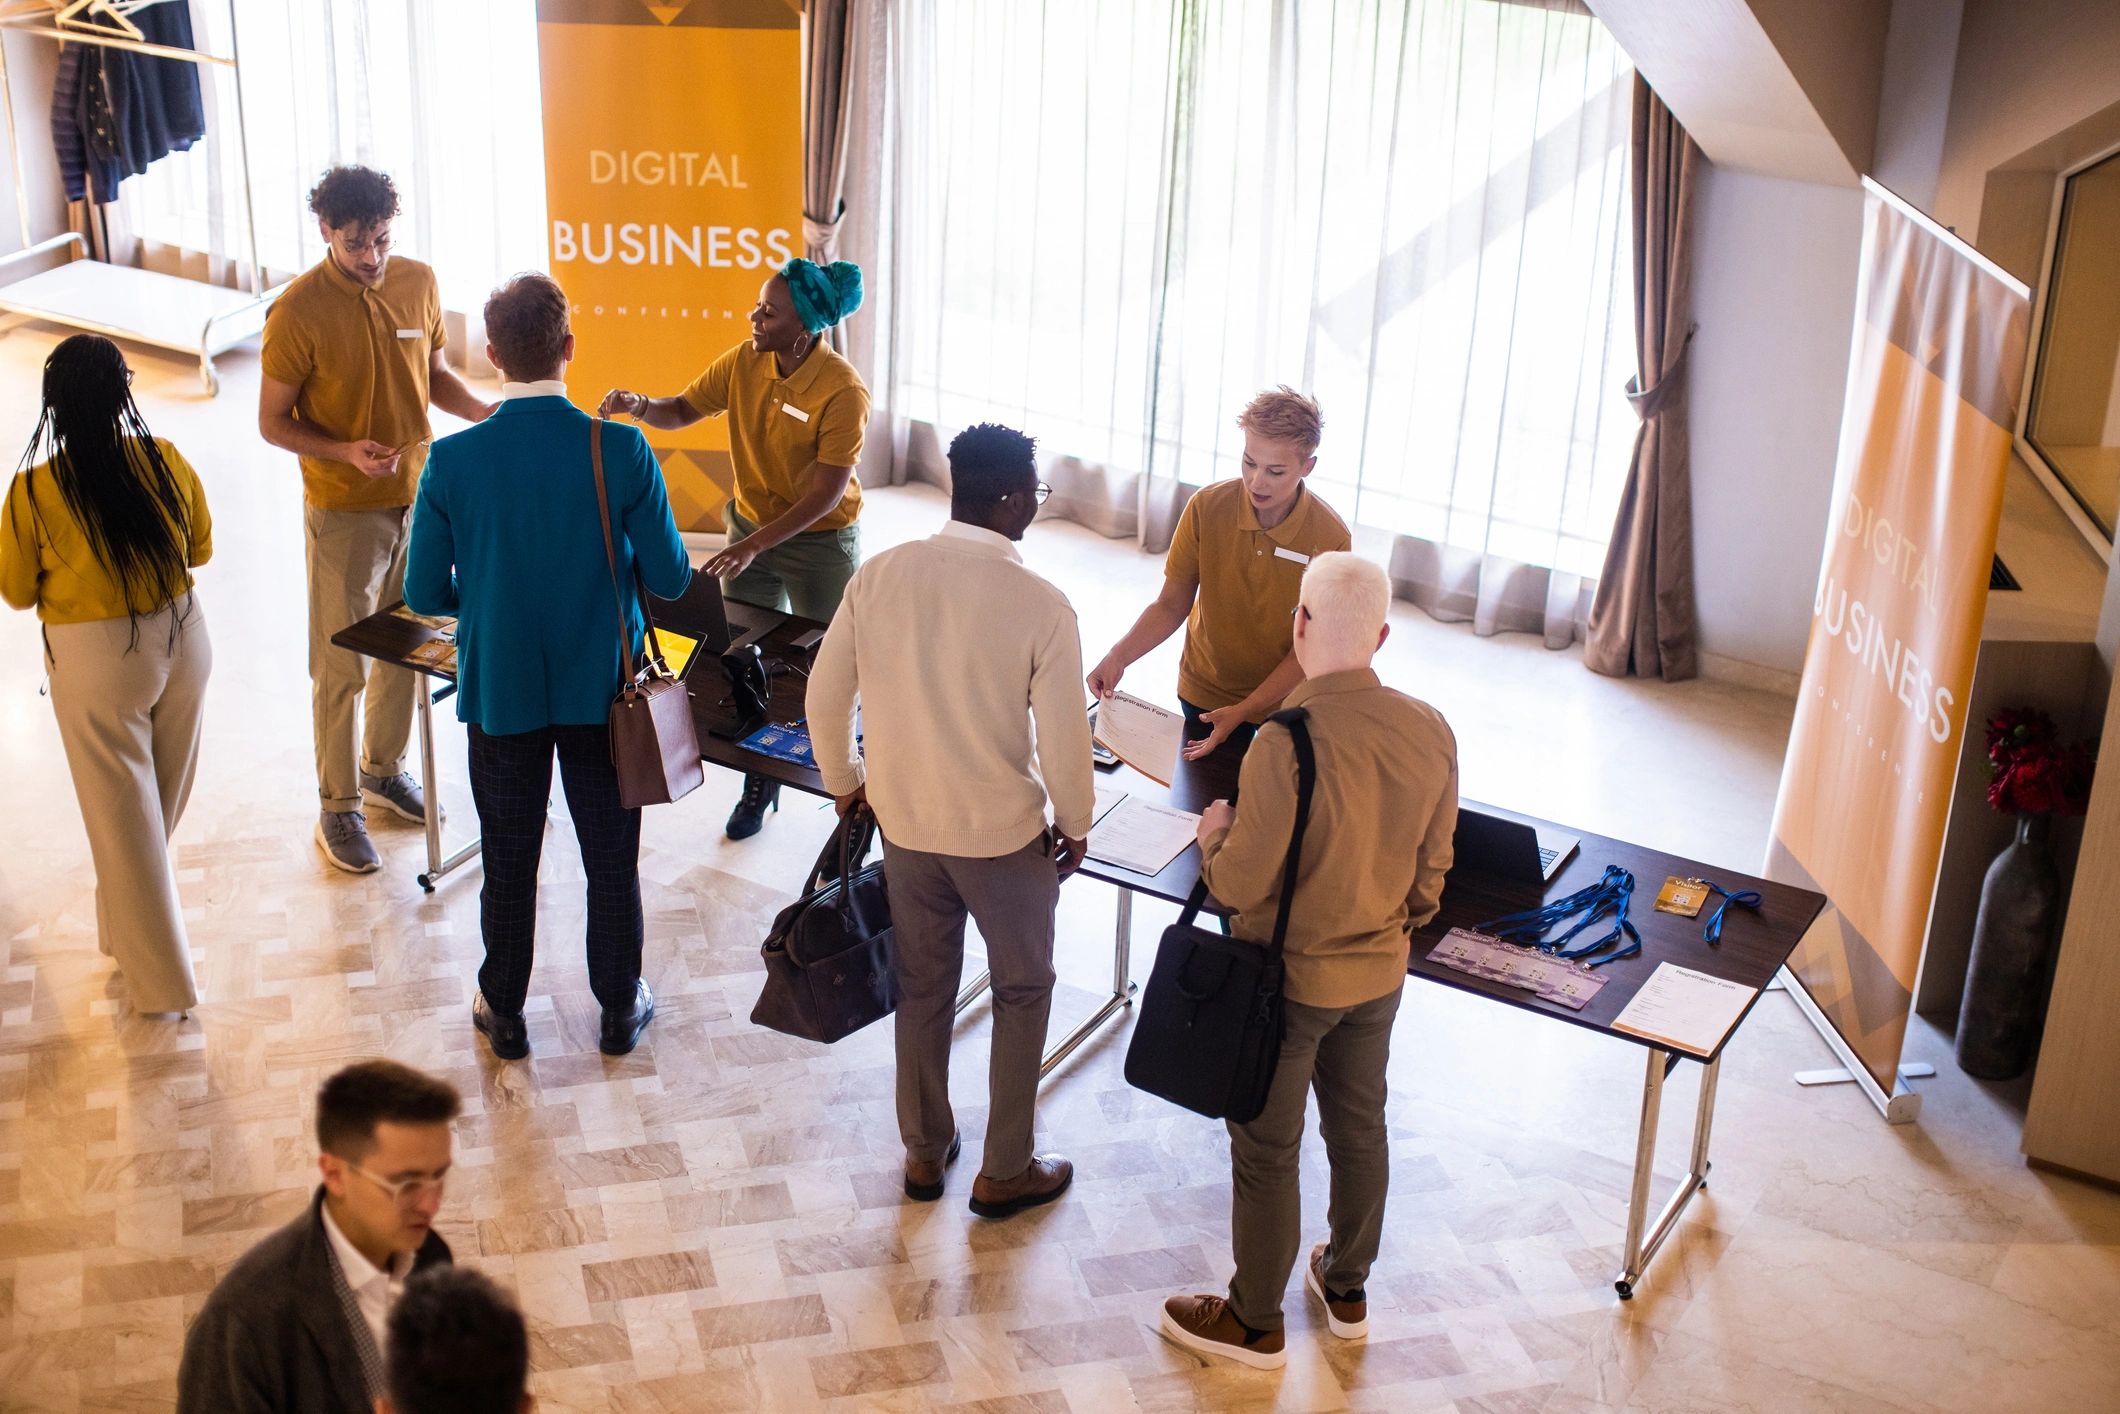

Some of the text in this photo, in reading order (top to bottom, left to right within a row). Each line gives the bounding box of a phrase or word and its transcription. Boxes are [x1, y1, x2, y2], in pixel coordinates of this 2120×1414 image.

[590, 150, 747, 188] DIGITAL
[553, 220, 792, 270] BUSINESS
[572, 304, 752, 321] CONFEREN
[1844, 492, 1939, 616] DIGITAL
[1114, 695, 1168, 718] Registration Form
[769, 723, 797, 735] Lecturer
[1814, 680, 1923, 804] ONFERENCE
[1675, 880, 1702, 890] Visitor
[1453, 929, 1490, 943] Organizer
[1675, 969, 1736, 990] Registration Form
